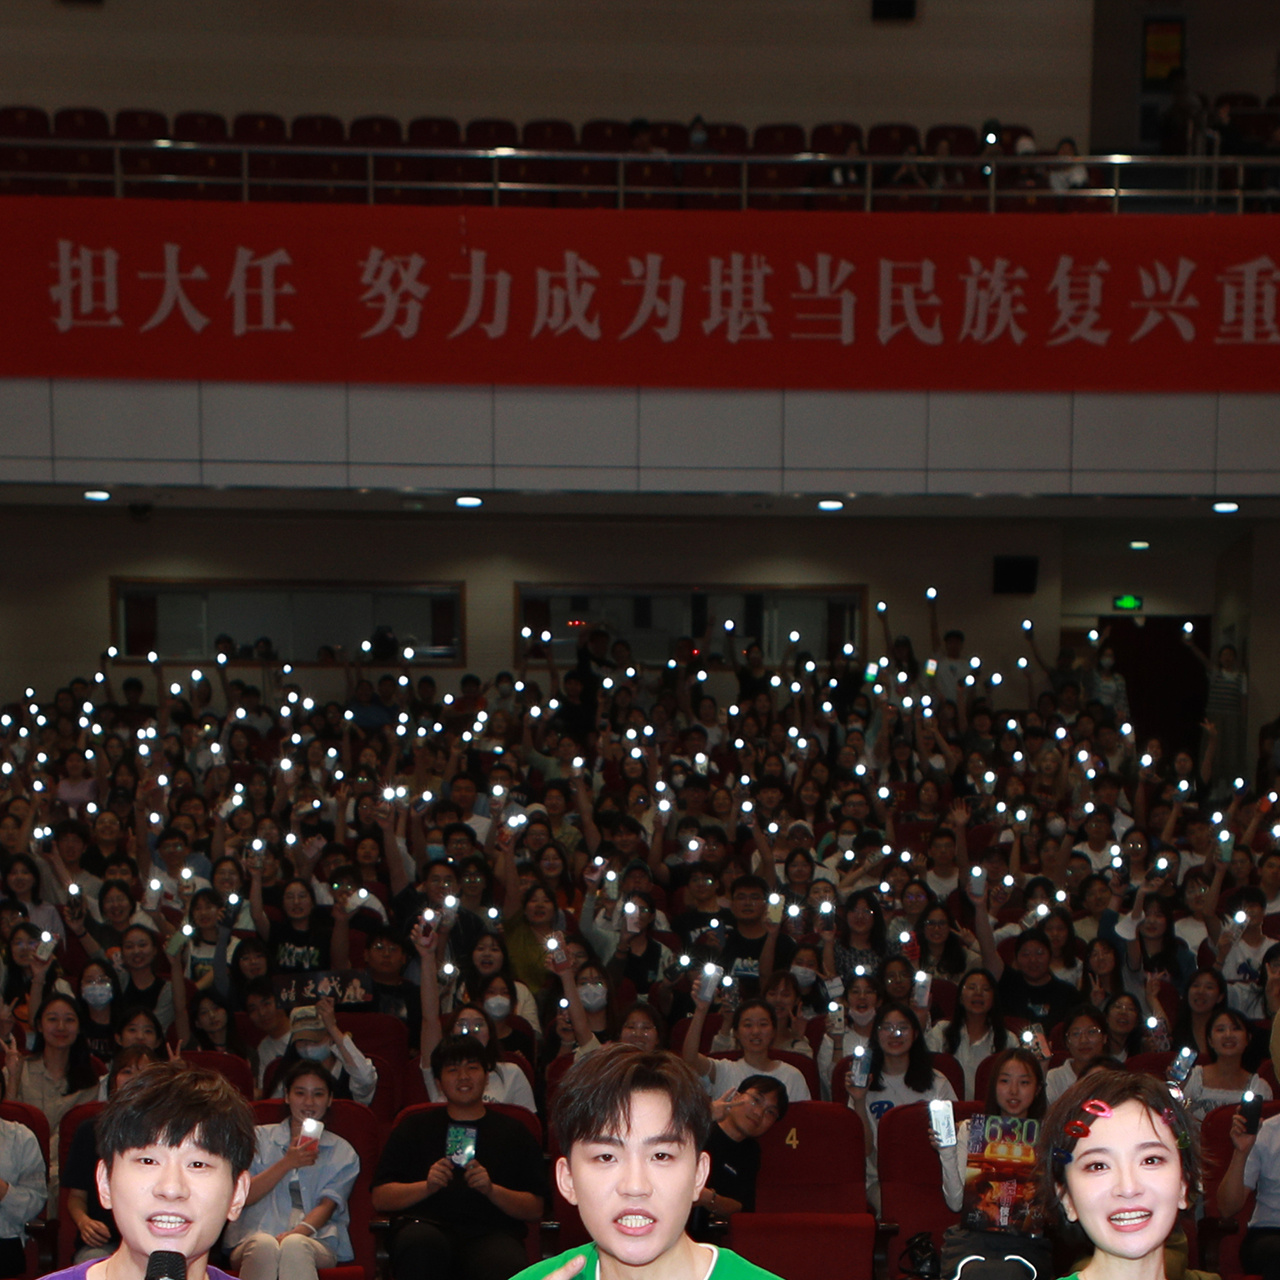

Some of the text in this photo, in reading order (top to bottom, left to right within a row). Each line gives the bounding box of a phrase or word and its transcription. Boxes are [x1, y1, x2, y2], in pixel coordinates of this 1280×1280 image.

[48, 238, 297, 337] 担大任
[785, 1127, 800, 1150] 4
